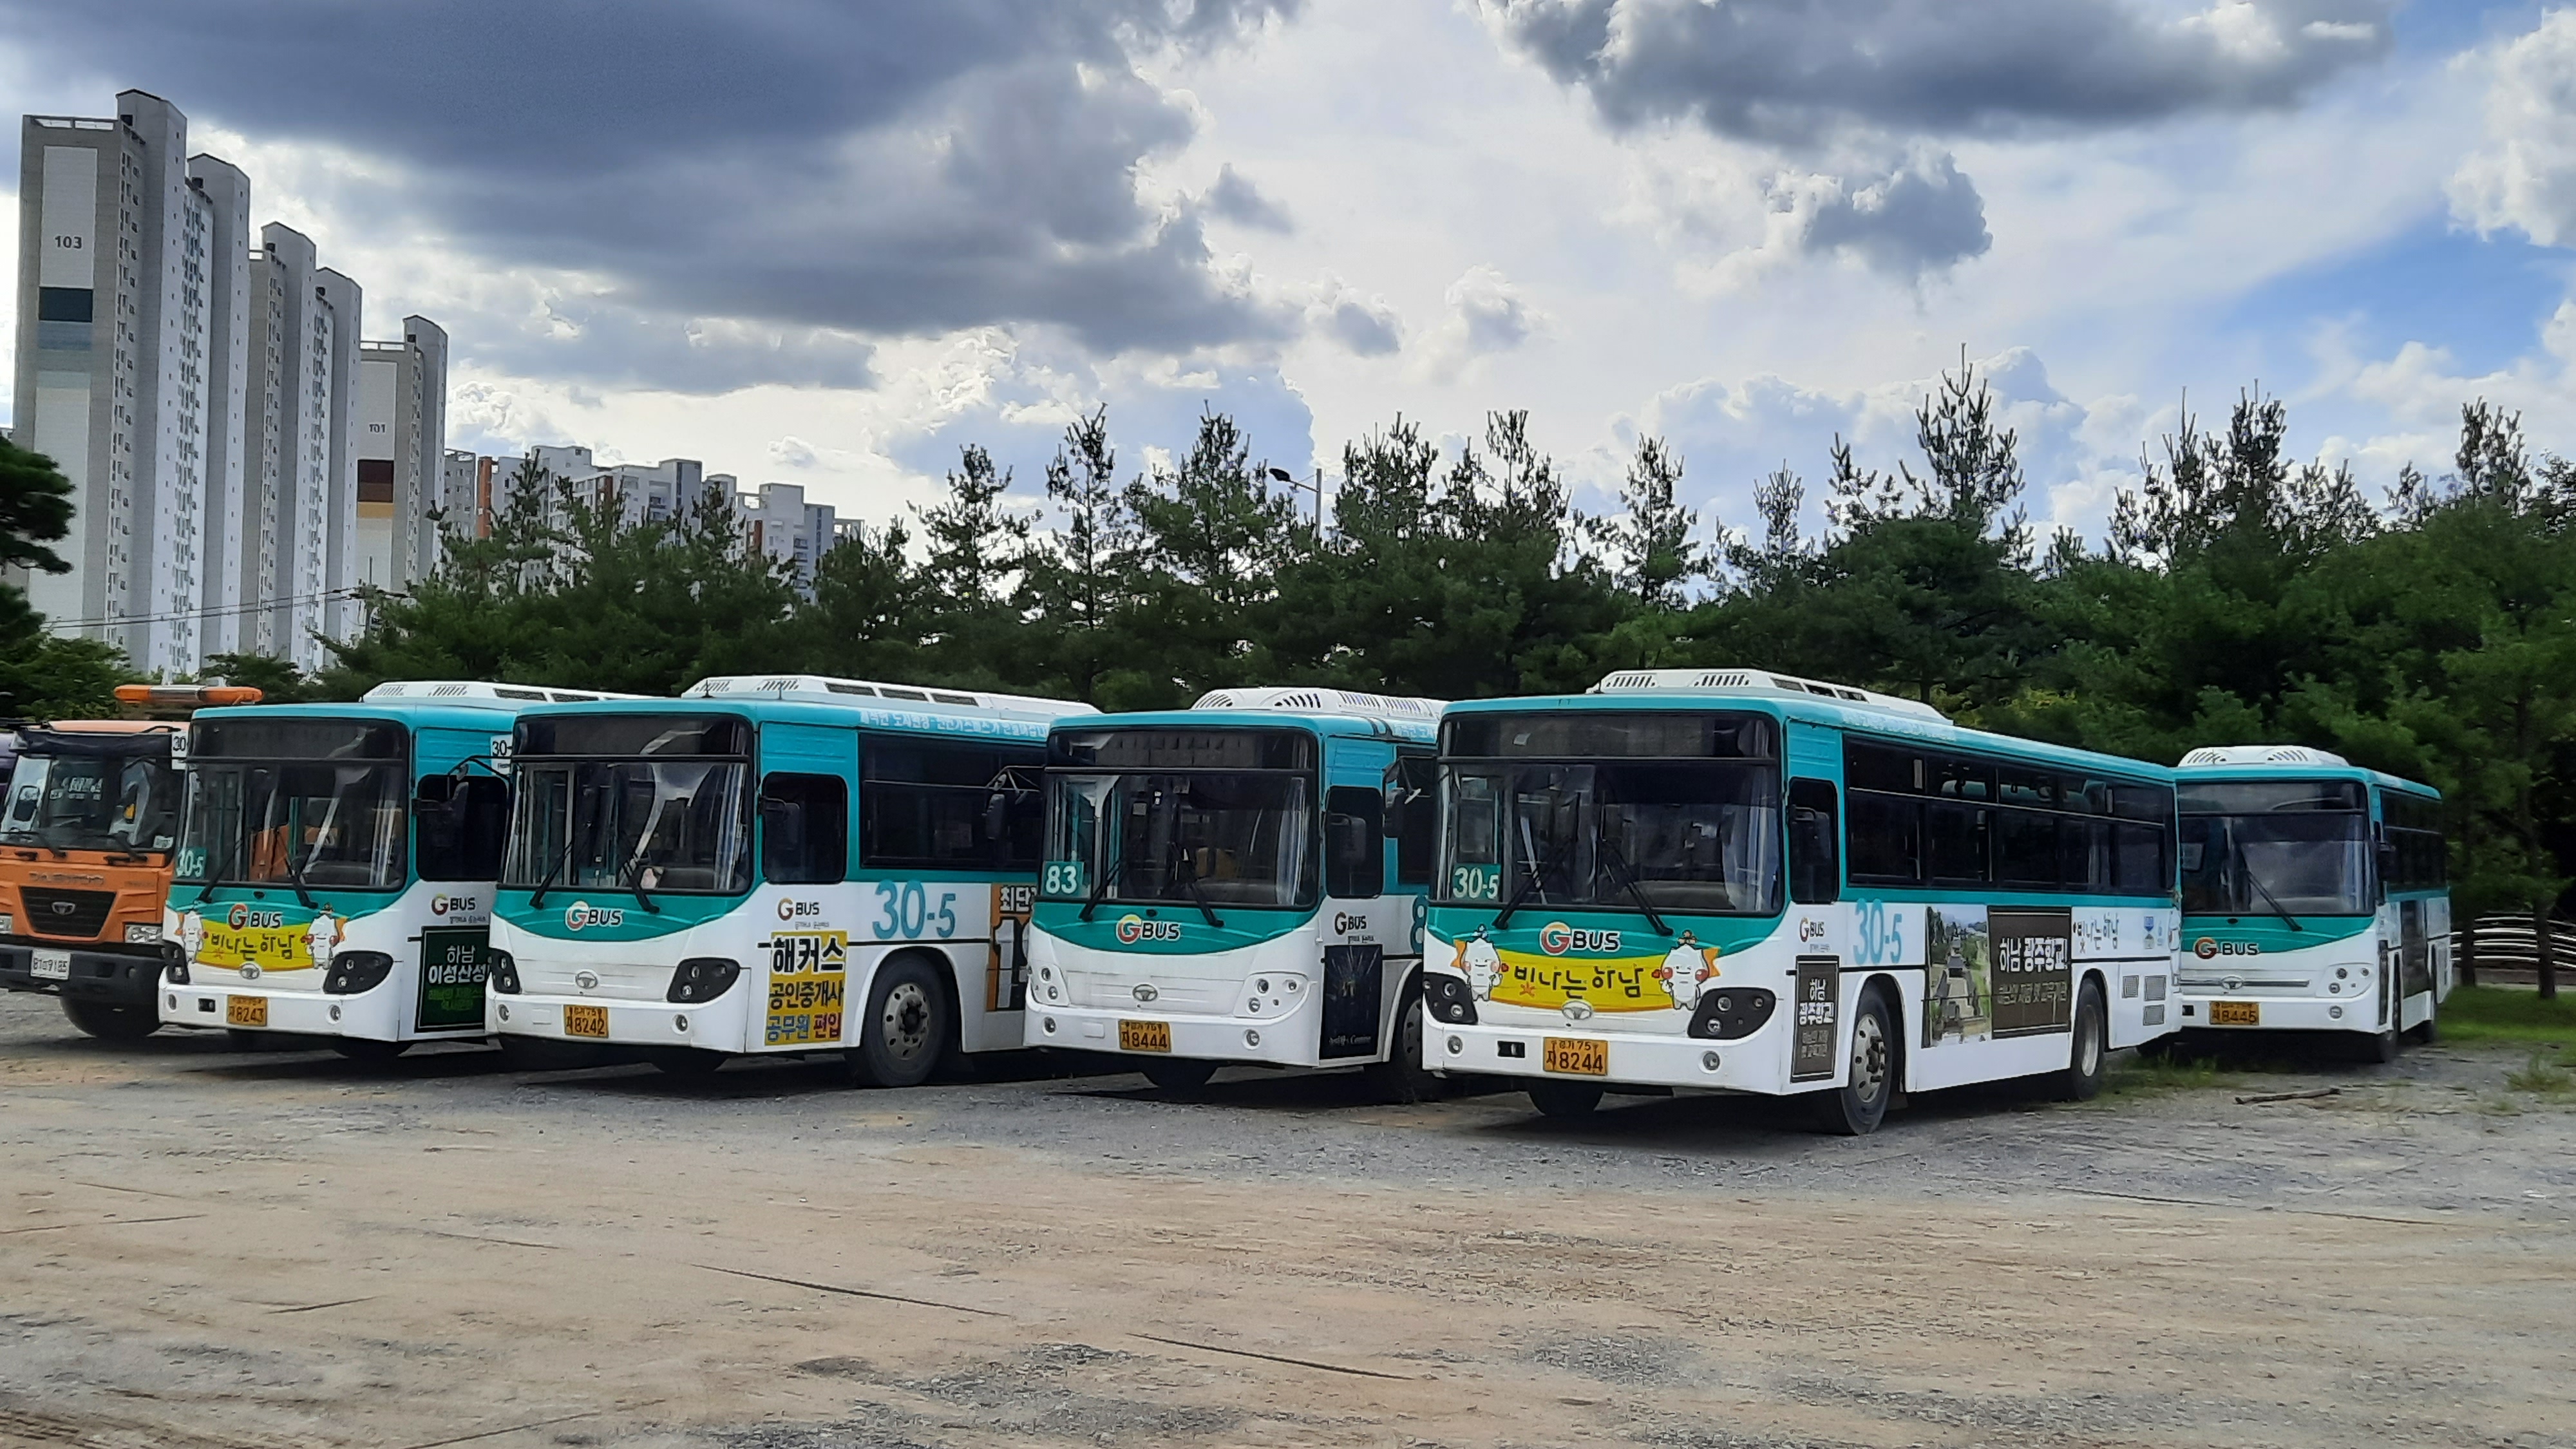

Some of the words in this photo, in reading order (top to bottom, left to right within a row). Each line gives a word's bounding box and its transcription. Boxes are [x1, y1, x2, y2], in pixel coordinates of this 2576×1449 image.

[54, 235, 82, 249] 103
[369, 423, 386, 433] 101
[176, 849, 204, 878] 30-5
[1045, 865, 1077, 894] 83
[1452, 867, 1499, 899] 30-5
[872, 880, 956, 939] 30-5
[1853, 898, 1902, 965] 30-5
[260, 934, 295, 960] 하남
[446, 945, 476, 964] 하남
[773, 937, 844, 973] 해커스
[1999, 937, 2022, 972] 하남
[428, 963, 486, 984] 이성산성
[1592, 965, 1644, 998] 하남
[770, 980, 844, 1010] 공인중개사
[767, 1014, 810, 1042] 공무원
[813, 1012, 842, 1039] 편입
